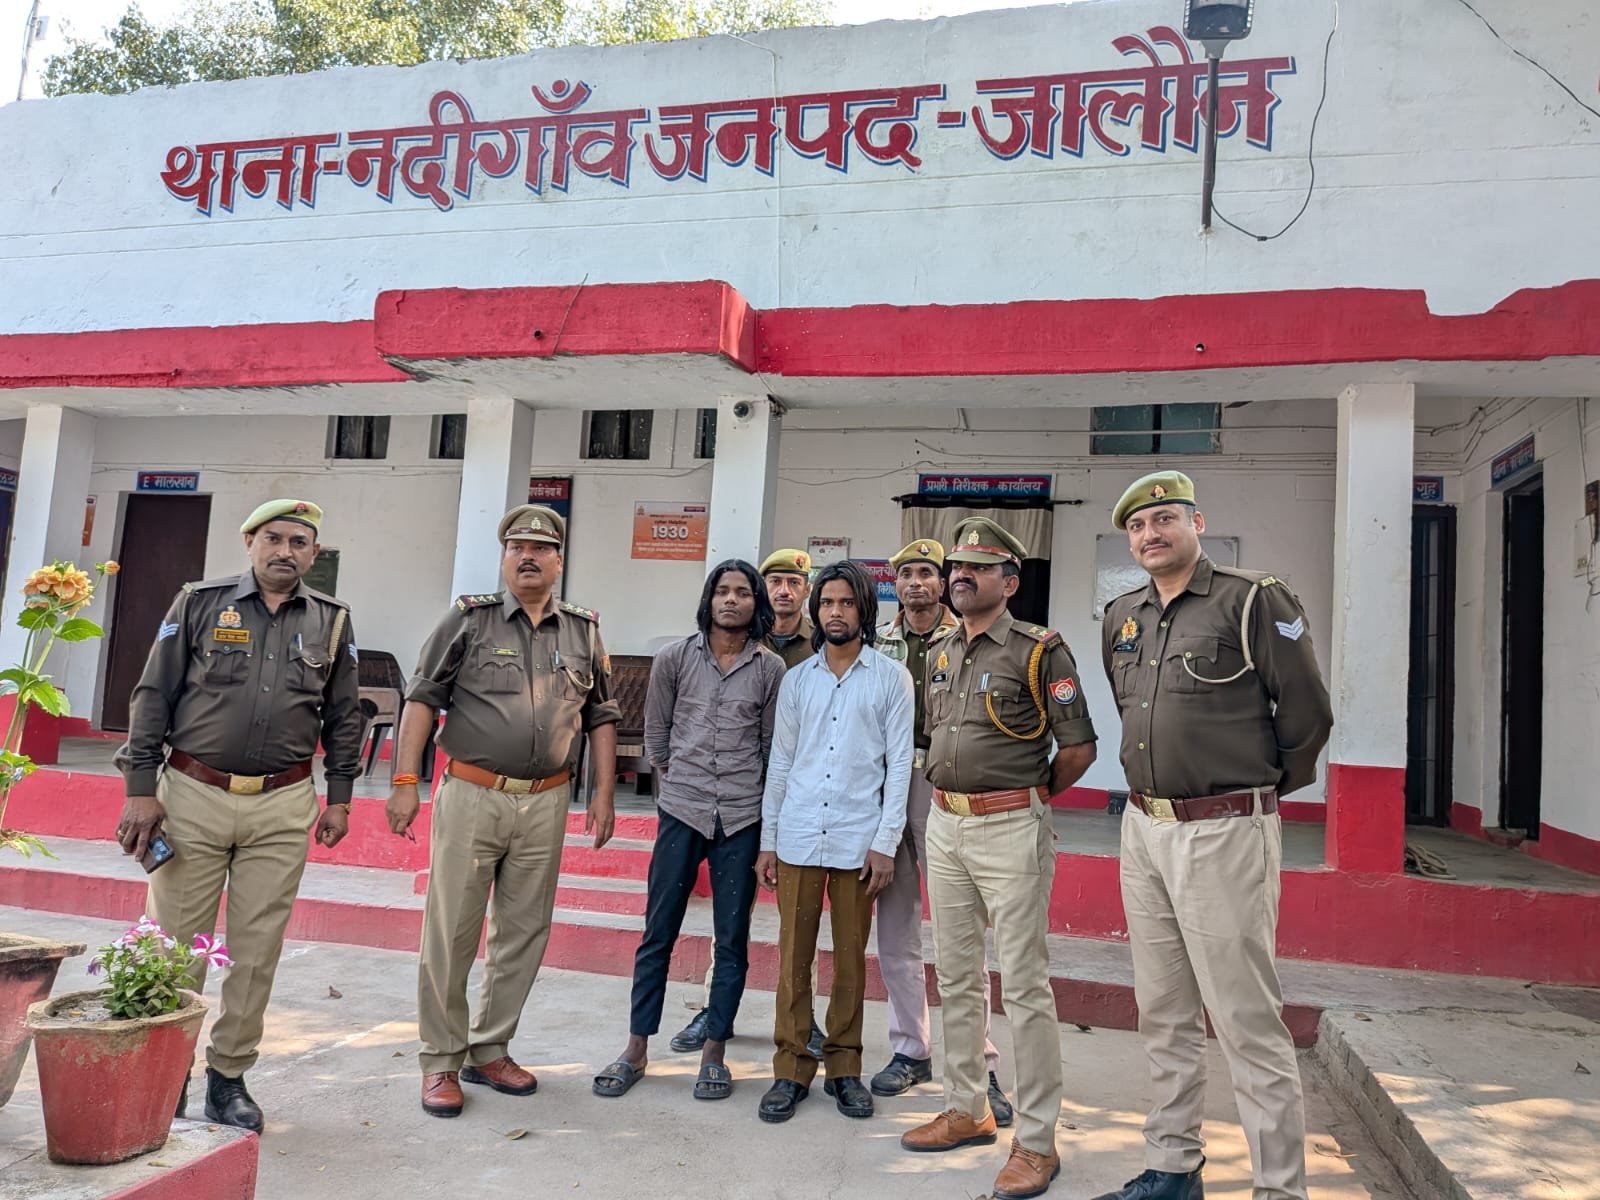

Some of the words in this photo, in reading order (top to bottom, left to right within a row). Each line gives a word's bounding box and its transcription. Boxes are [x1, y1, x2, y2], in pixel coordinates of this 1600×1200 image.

[154, 475, 196, 489] मालखाना
[925, 477, 948, 493] प्रभारी
[952, 477, 989, 493] निरीक्षक
[997, 477, 1044, 494] कार्यालय
[1415, 481, 1438, 499] गृह
[651, 524, 689, 540] 1930
